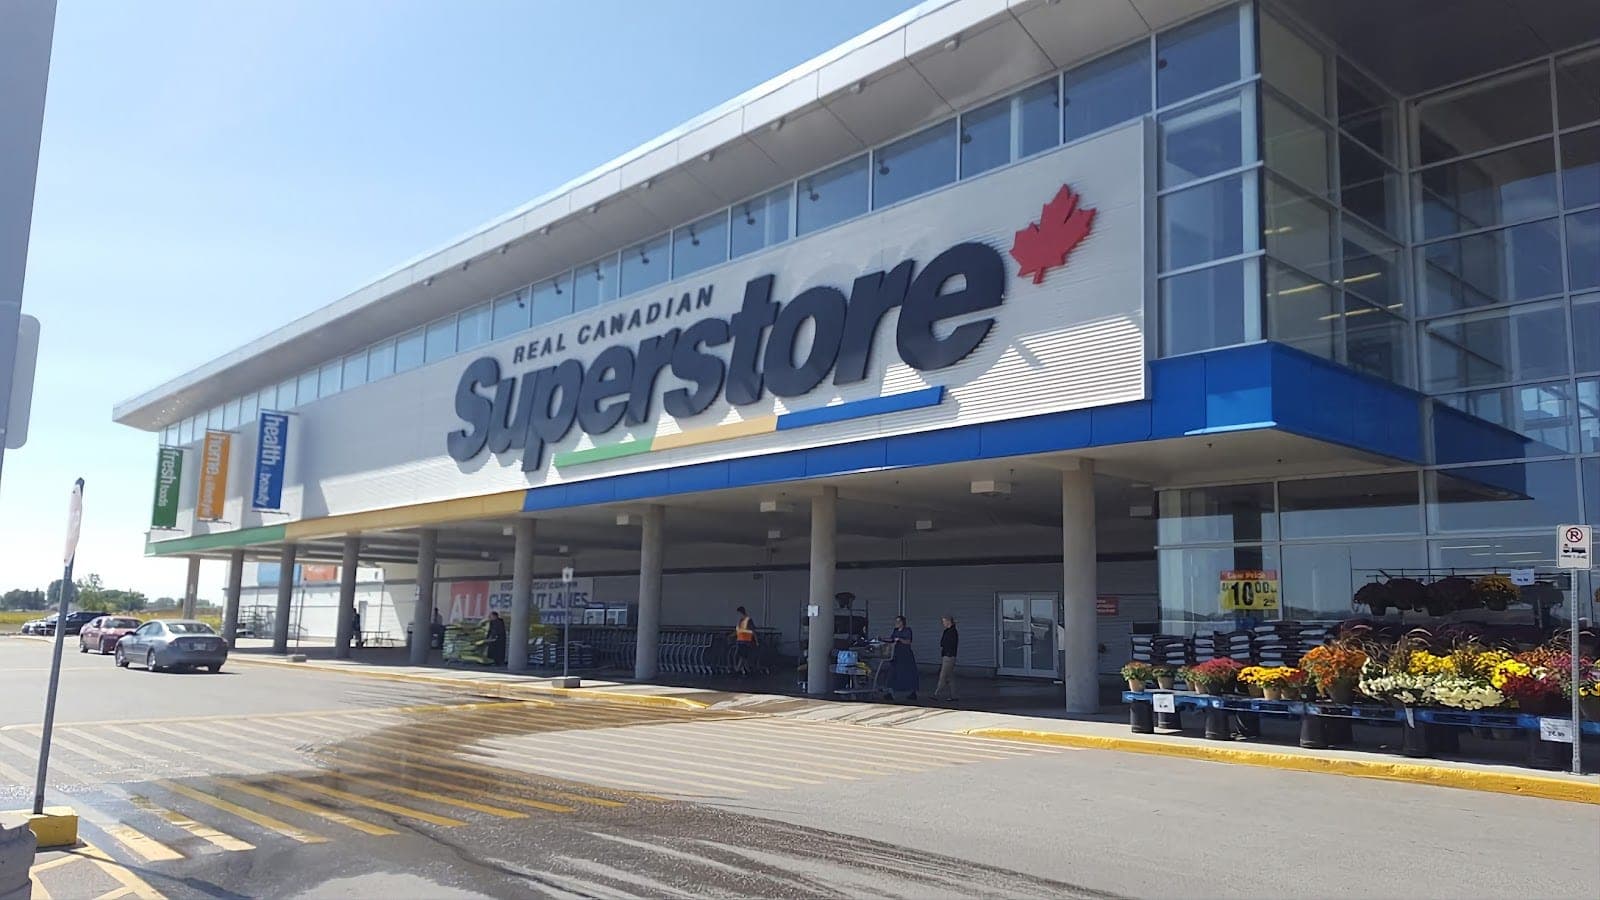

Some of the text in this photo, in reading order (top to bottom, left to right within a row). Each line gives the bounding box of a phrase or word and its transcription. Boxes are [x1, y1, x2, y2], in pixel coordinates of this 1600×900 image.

[513, 284, 714, 364] REAL CANADIAN
[447, 241, 1006, 472] Superstore
[261, 415, 284, 466] health
[160, 449, 179, 484] fresh
[450, 593, 485, 624] ALL
